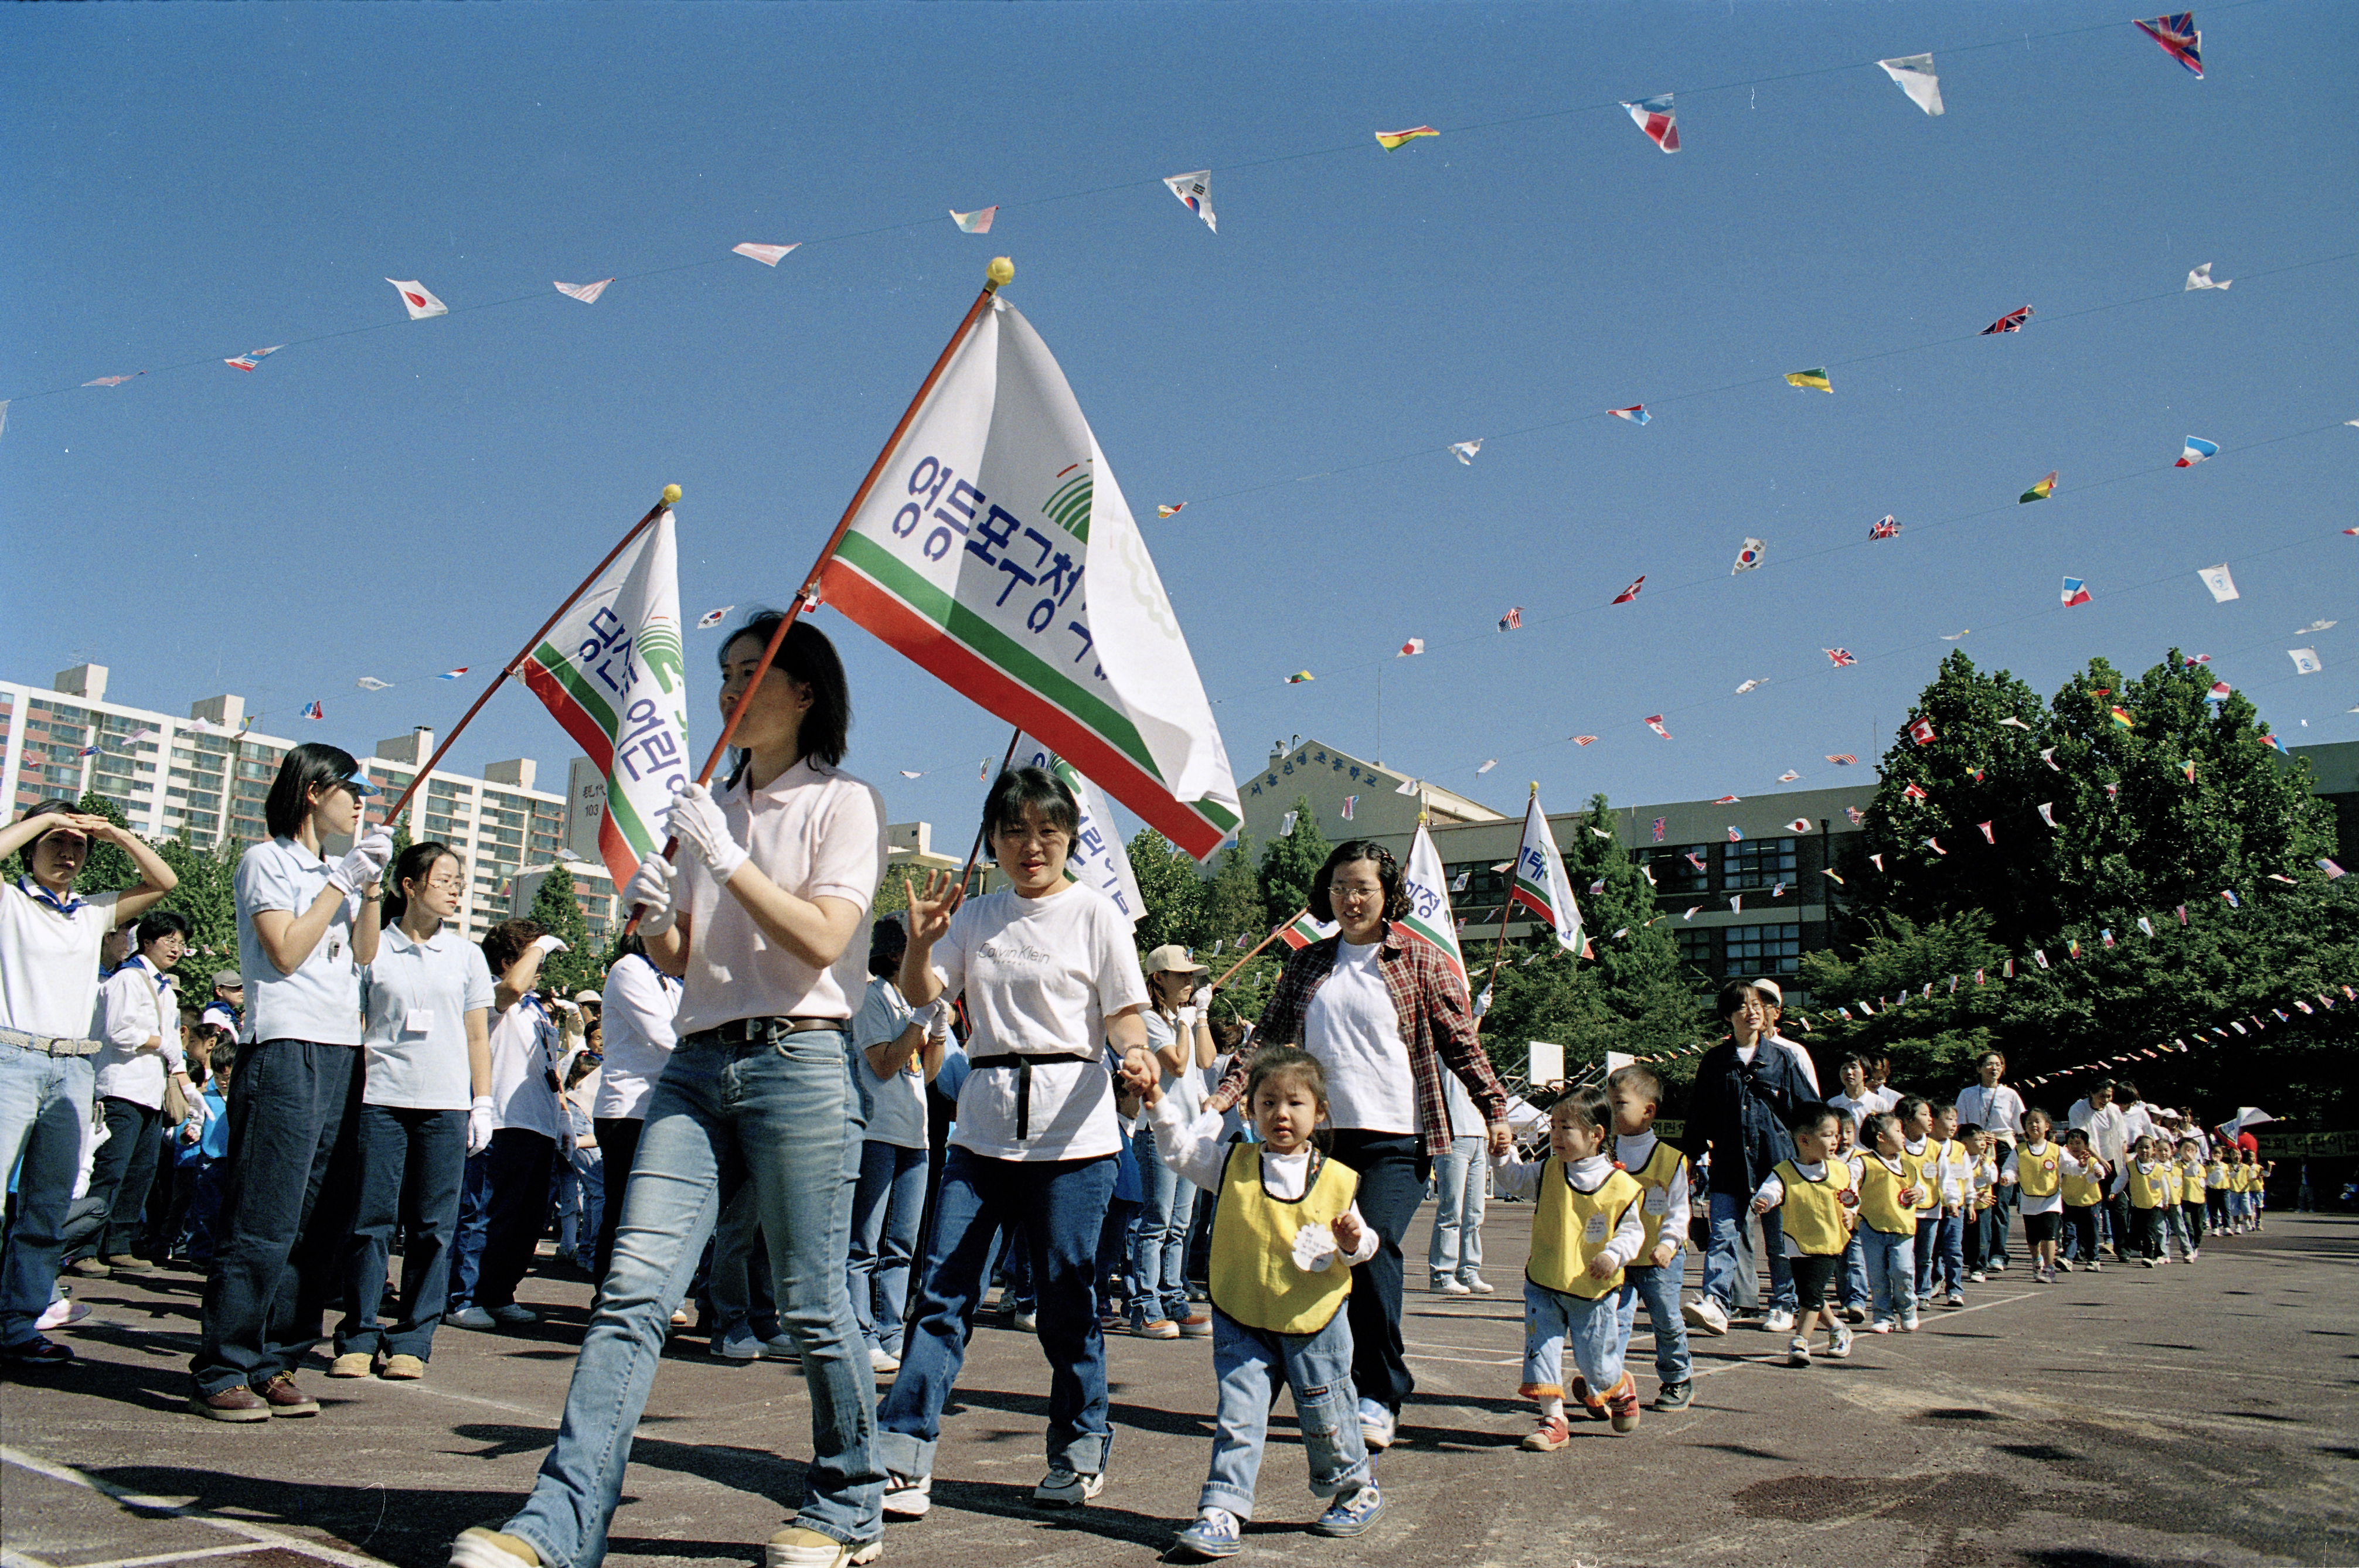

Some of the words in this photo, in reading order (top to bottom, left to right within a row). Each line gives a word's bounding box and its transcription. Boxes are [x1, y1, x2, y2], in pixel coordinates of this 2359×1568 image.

[586, 804, 598, 816] 103
[978, 943, 1017, 958] Calvin
[1019, 945, 1050, 964] Klein
